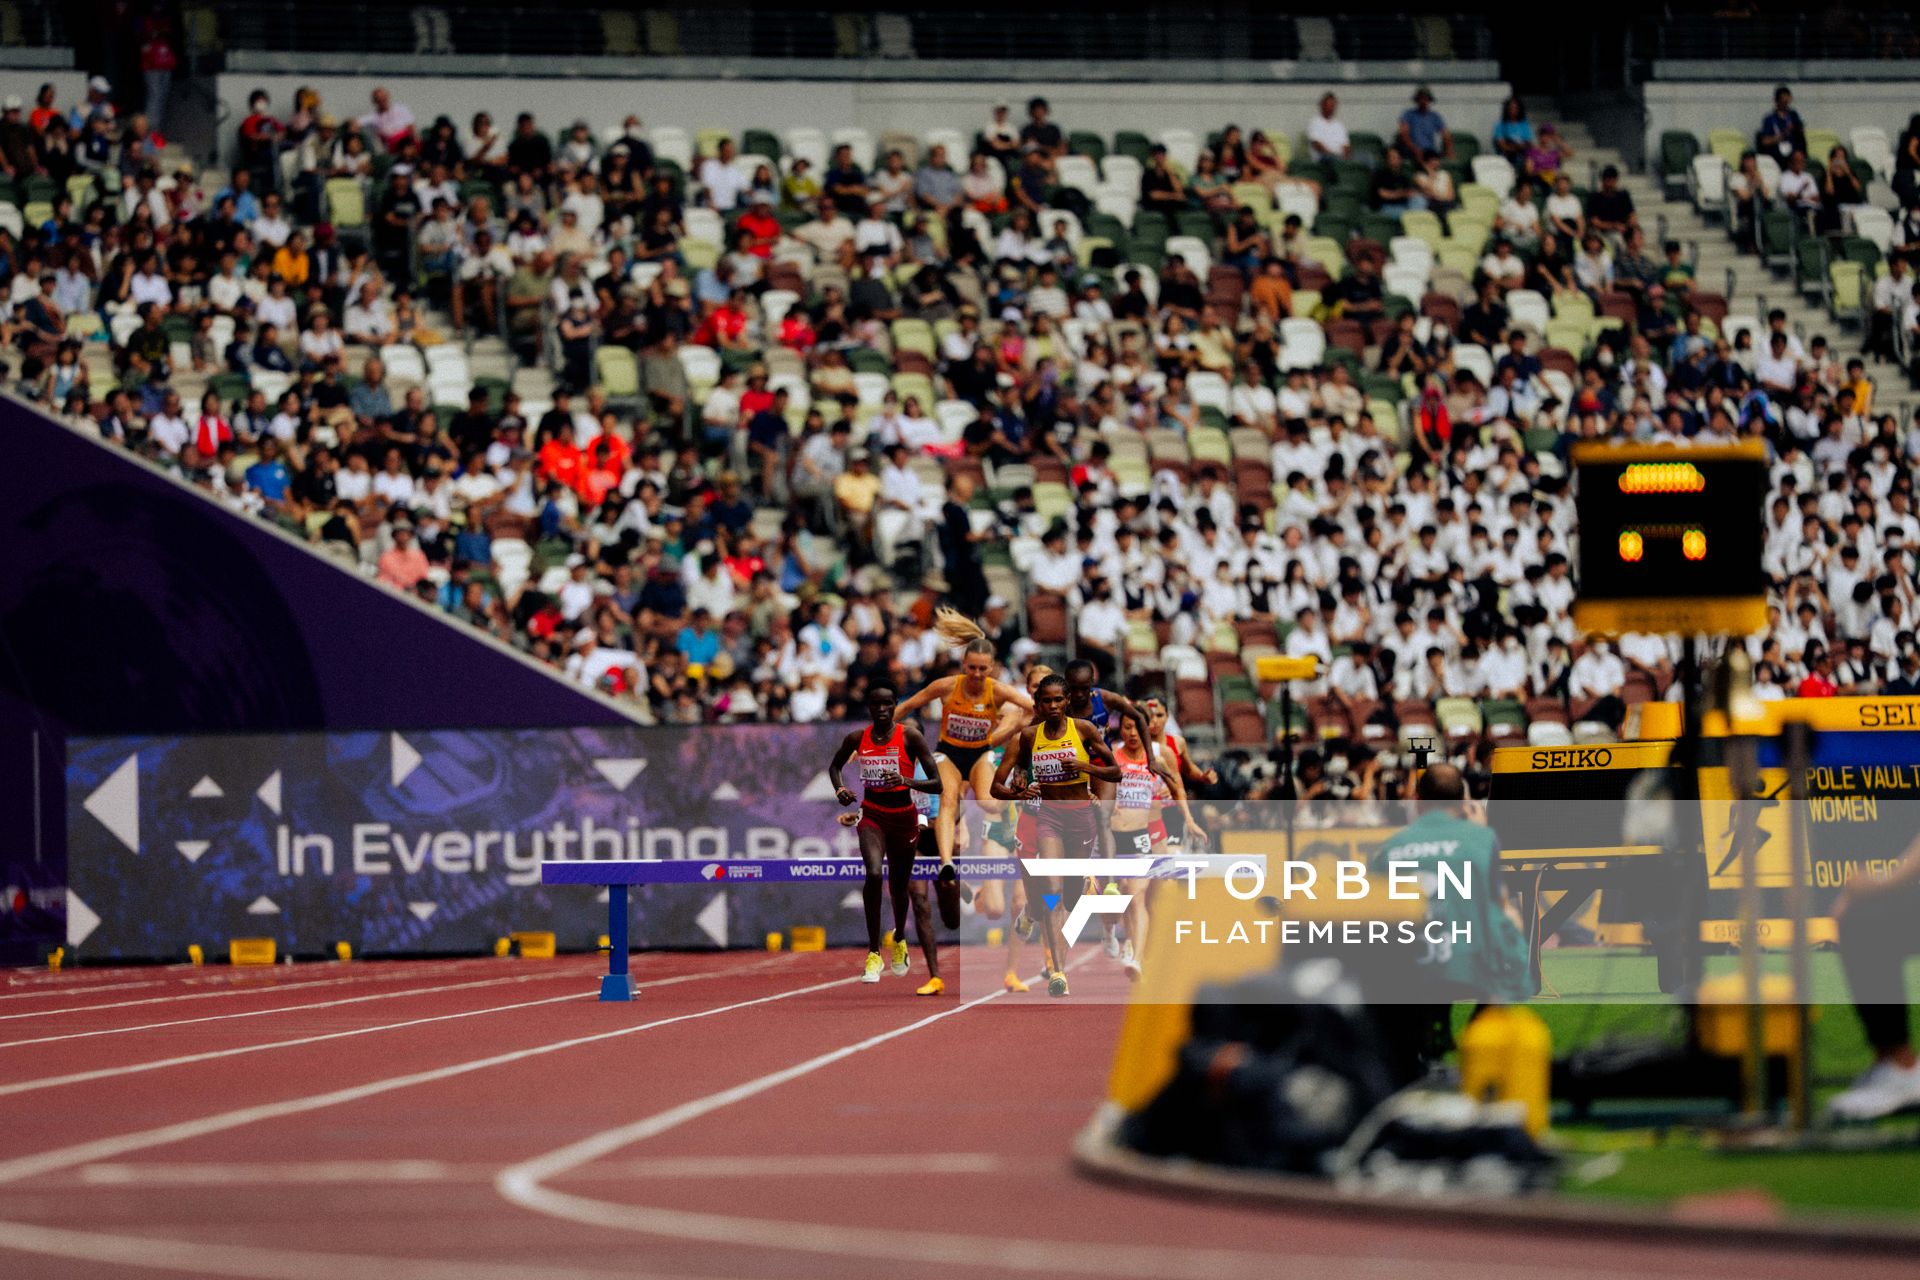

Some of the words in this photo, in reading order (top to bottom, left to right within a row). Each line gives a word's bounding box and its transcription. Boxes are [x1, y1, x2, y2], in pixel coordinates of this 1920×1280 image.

[950, 717, 989, 728] HONDA
[950, 723, 987, 736] MEYER
[1033, 751, 1076, 761] HONDA
[1532, 748, 1612, 769] SEIKO
[1805, 766, 1856, 791] POLE
[1860, 764, 1920, 790] VAULT
[1117, 790, 1149, 800] SAITO
[1808, 795, 1878, 823] WOMEN
[277, 825, 334, 876] In
[789, 865, 836, 876] WORLD
[911, 863, 1016, 875] CHAIONSHIPS
